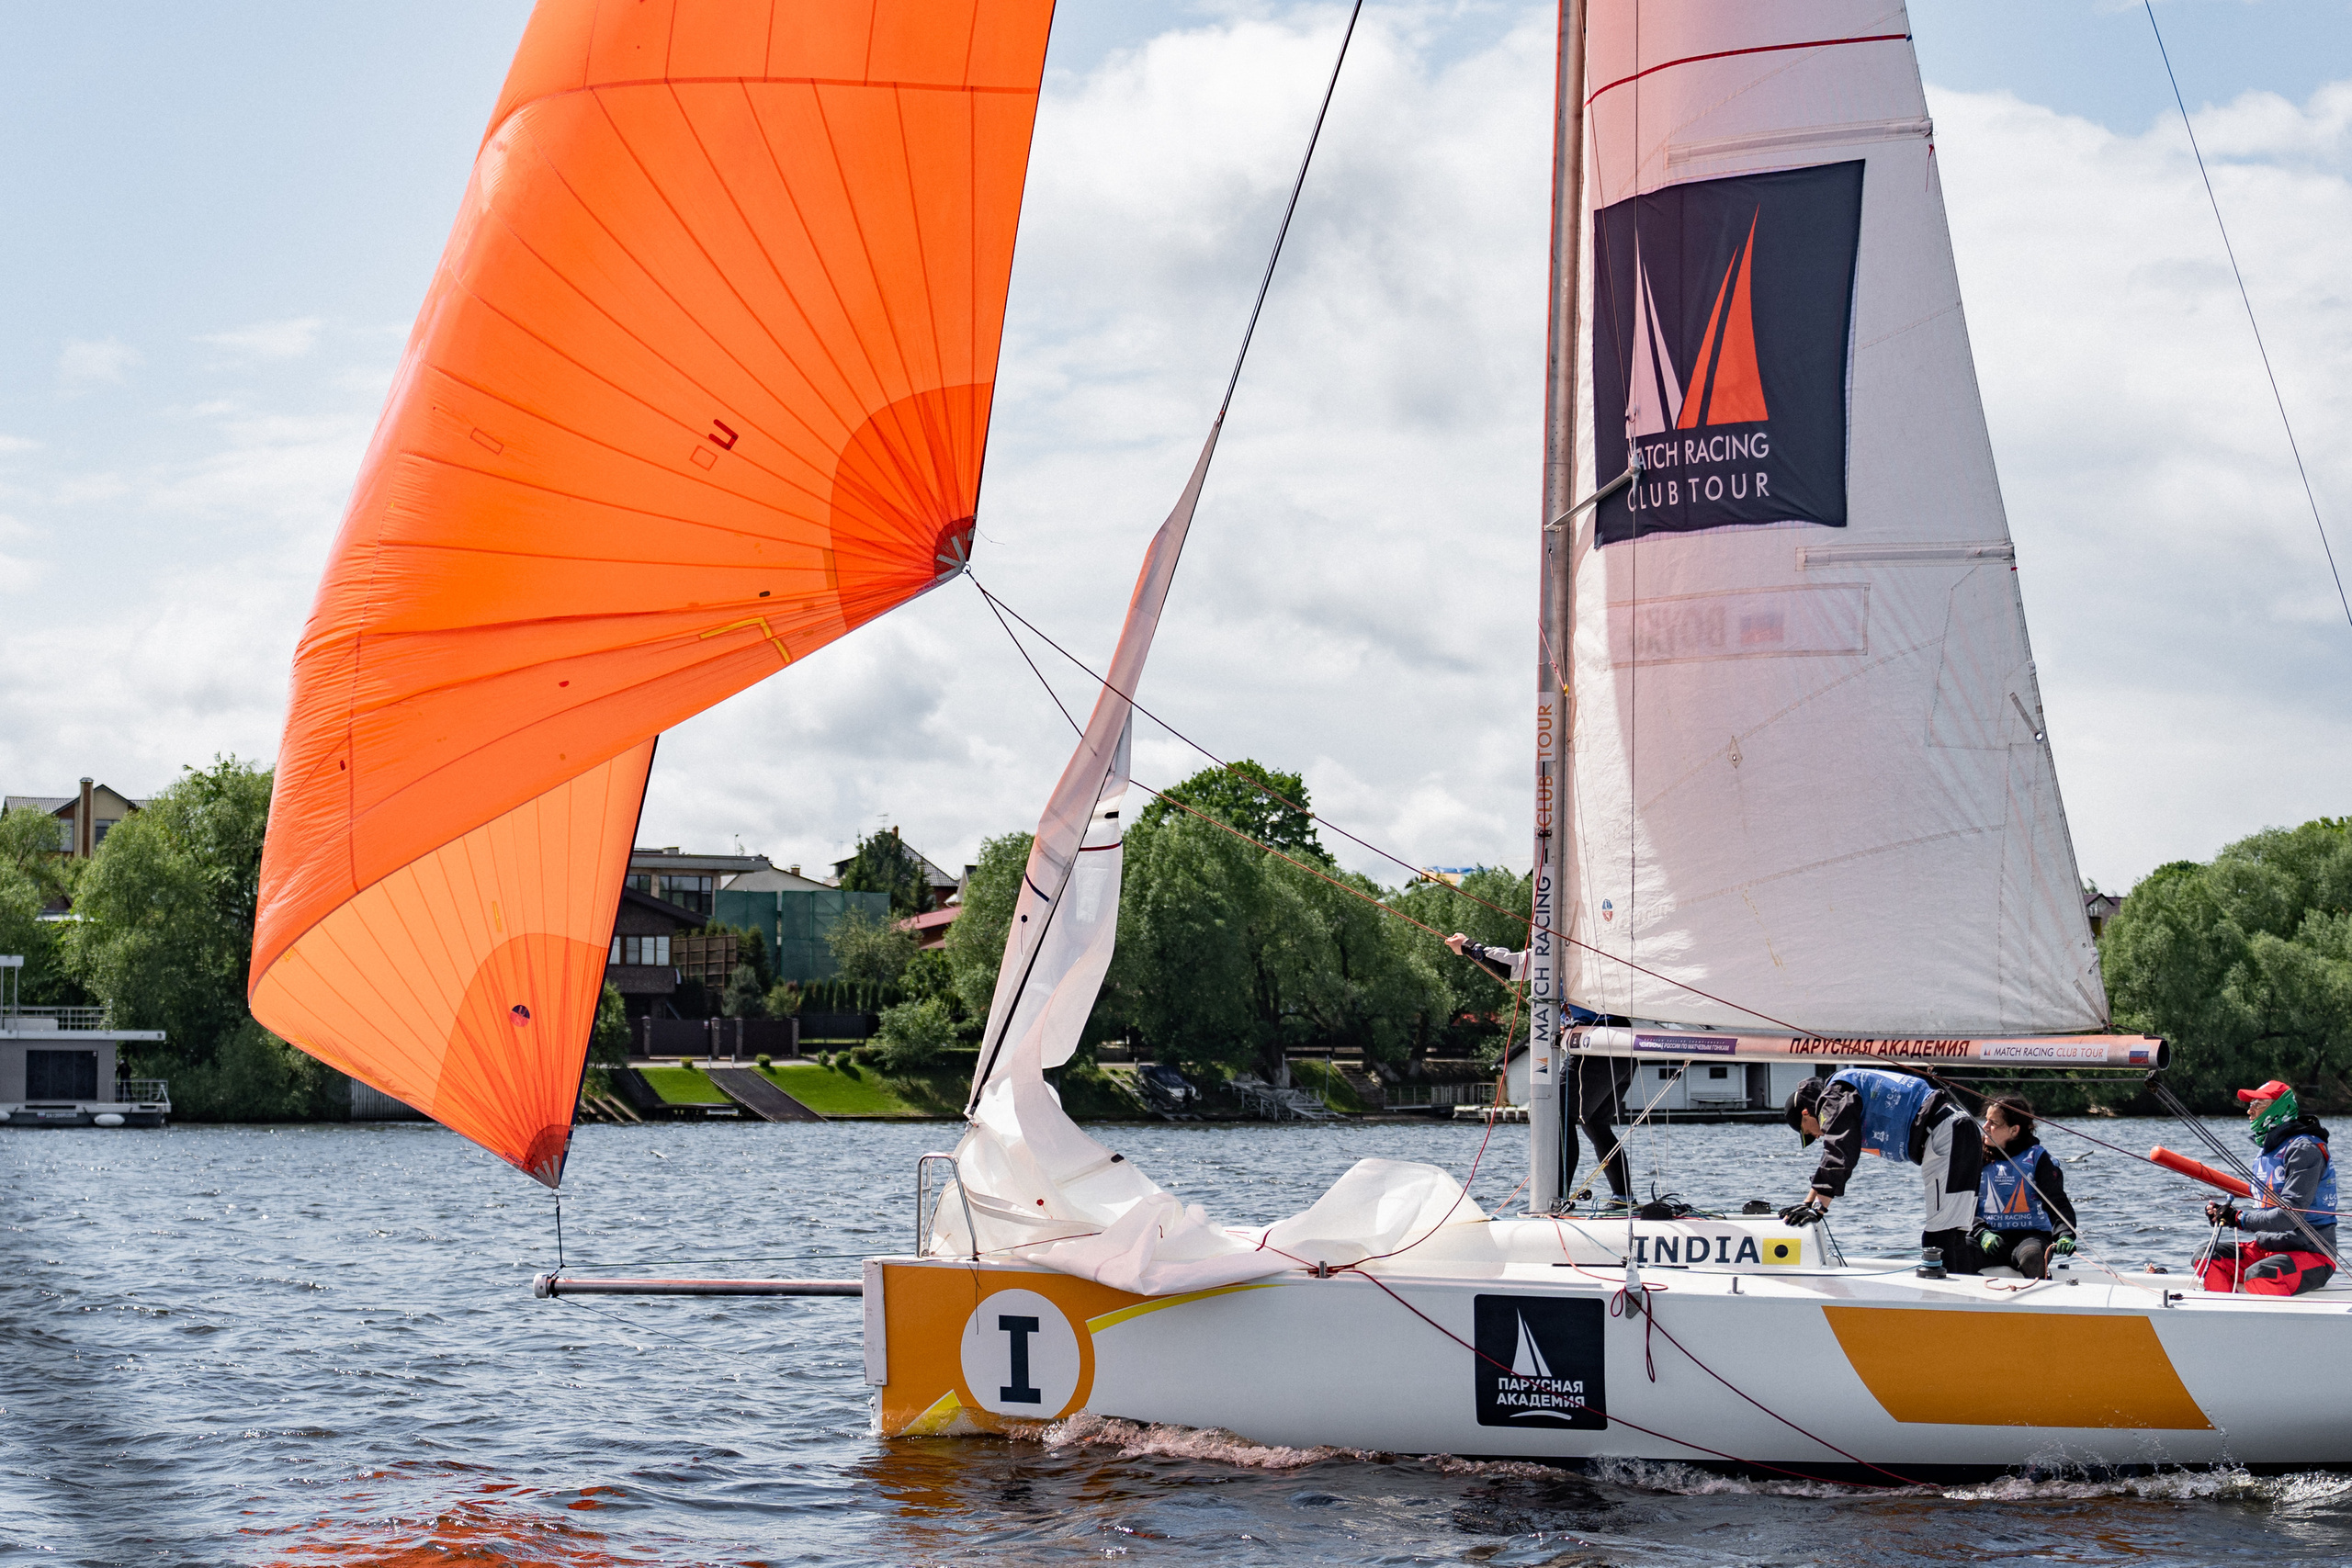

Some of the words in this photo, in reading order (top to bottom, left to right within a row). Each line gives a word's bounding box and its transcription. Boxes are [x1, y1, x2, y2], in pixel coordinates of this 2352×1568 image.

[1627, 442, 1679, 471] ATCH
[1684, 432, 1770, 465] RACING
[1627, 480, 1679, 513] CLUB
[1688, 471, 1770, 503] TOUR
[1537, 703, 1553, 761] TOUR
[1536, 774, 1554, 828] CLUB
[1534, 875, 1552, 957] RACING
[1789, 1037, 1874, 1055] ПАРУСНАЯ
[1877, 1039, 1971, 1059] АКАДЕМИЯ
[1993, 1046, 2021, 1056] MATCH
[2022, 1047, 2054, 1057] RACING
[2055, 1047, 2078, 1057] CLUB
[2080, 1048, 2104, 1058] TOUR
[1634, 1235, 1760, 1264] INDIA
[998, 1314, 1042, 1404] I
[1496, 1393, 1586, 1408] АКАДЕМИЯ
[1498, 1377, 1584, 1393] ПАРУСНАЯ
